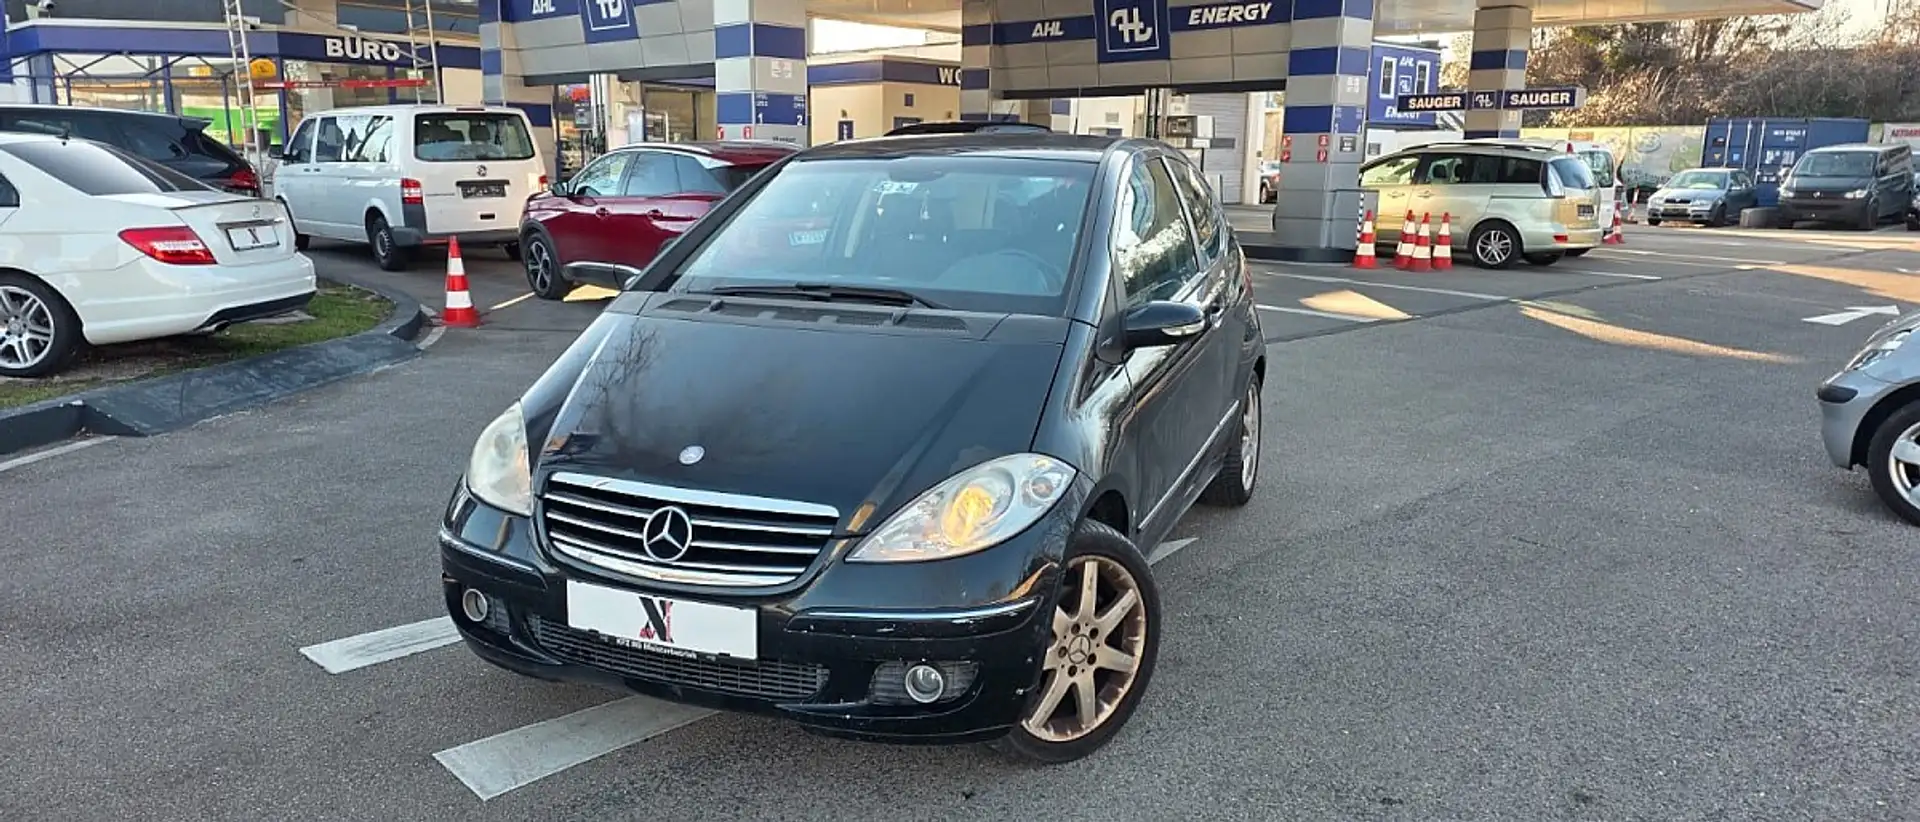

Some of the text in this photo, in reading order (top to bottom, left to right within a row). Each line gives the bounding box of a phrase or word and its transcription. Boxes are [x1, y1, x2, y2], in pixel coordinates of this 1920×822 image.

[1032, 22, 1065, 38] AHL
[1188, 2, 1273, 25] ENERGY
[1408, 96, 1461, 110] SAUGER
[1510, 92, 1571, 106] SAUGER
[757, 112, 763, 125] 1
[796, 114, 803, 126] 2
